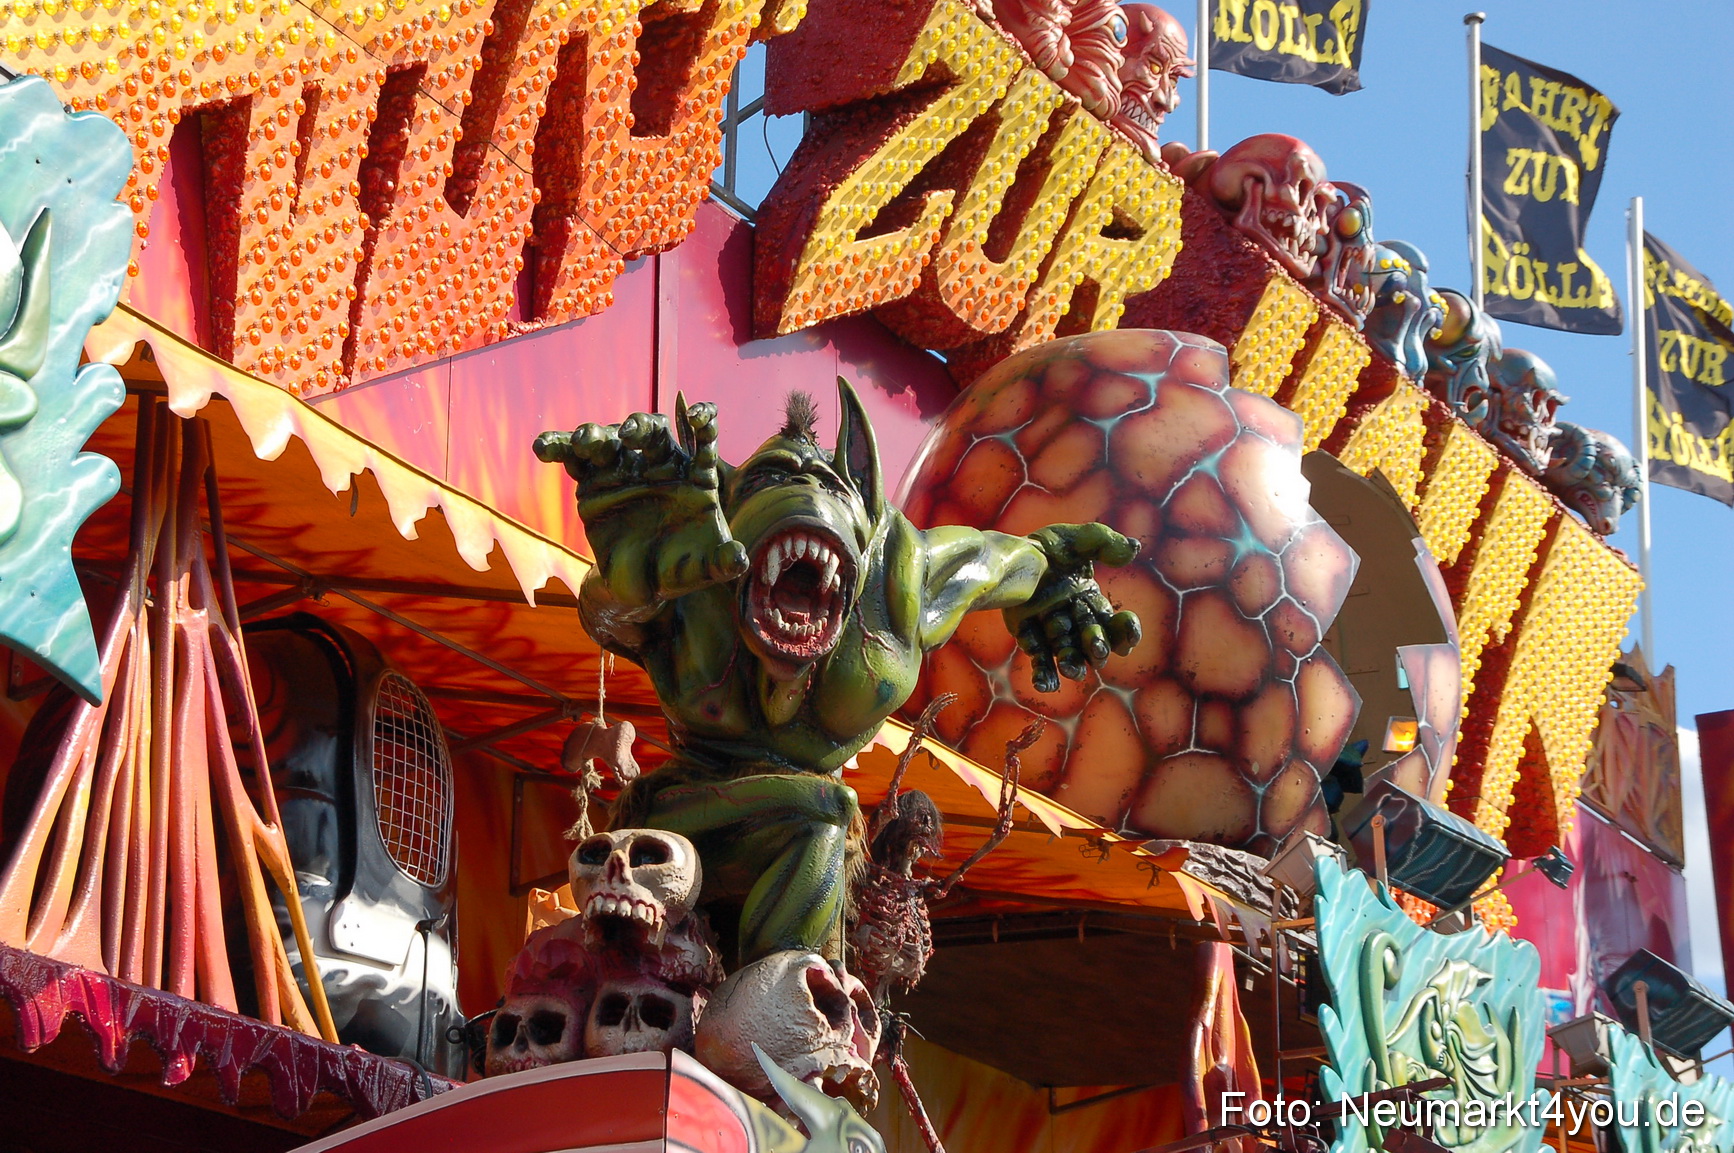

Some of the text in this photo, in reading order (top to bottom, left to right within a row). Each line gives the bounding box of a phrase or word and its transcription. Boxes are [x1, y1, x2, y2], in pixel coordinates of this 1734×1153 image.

[1480, 64, 1613, 171] FAHRT
[777, 0, 1184, 354] ZUR
[1658, 329, 1728, 386] ZUR
